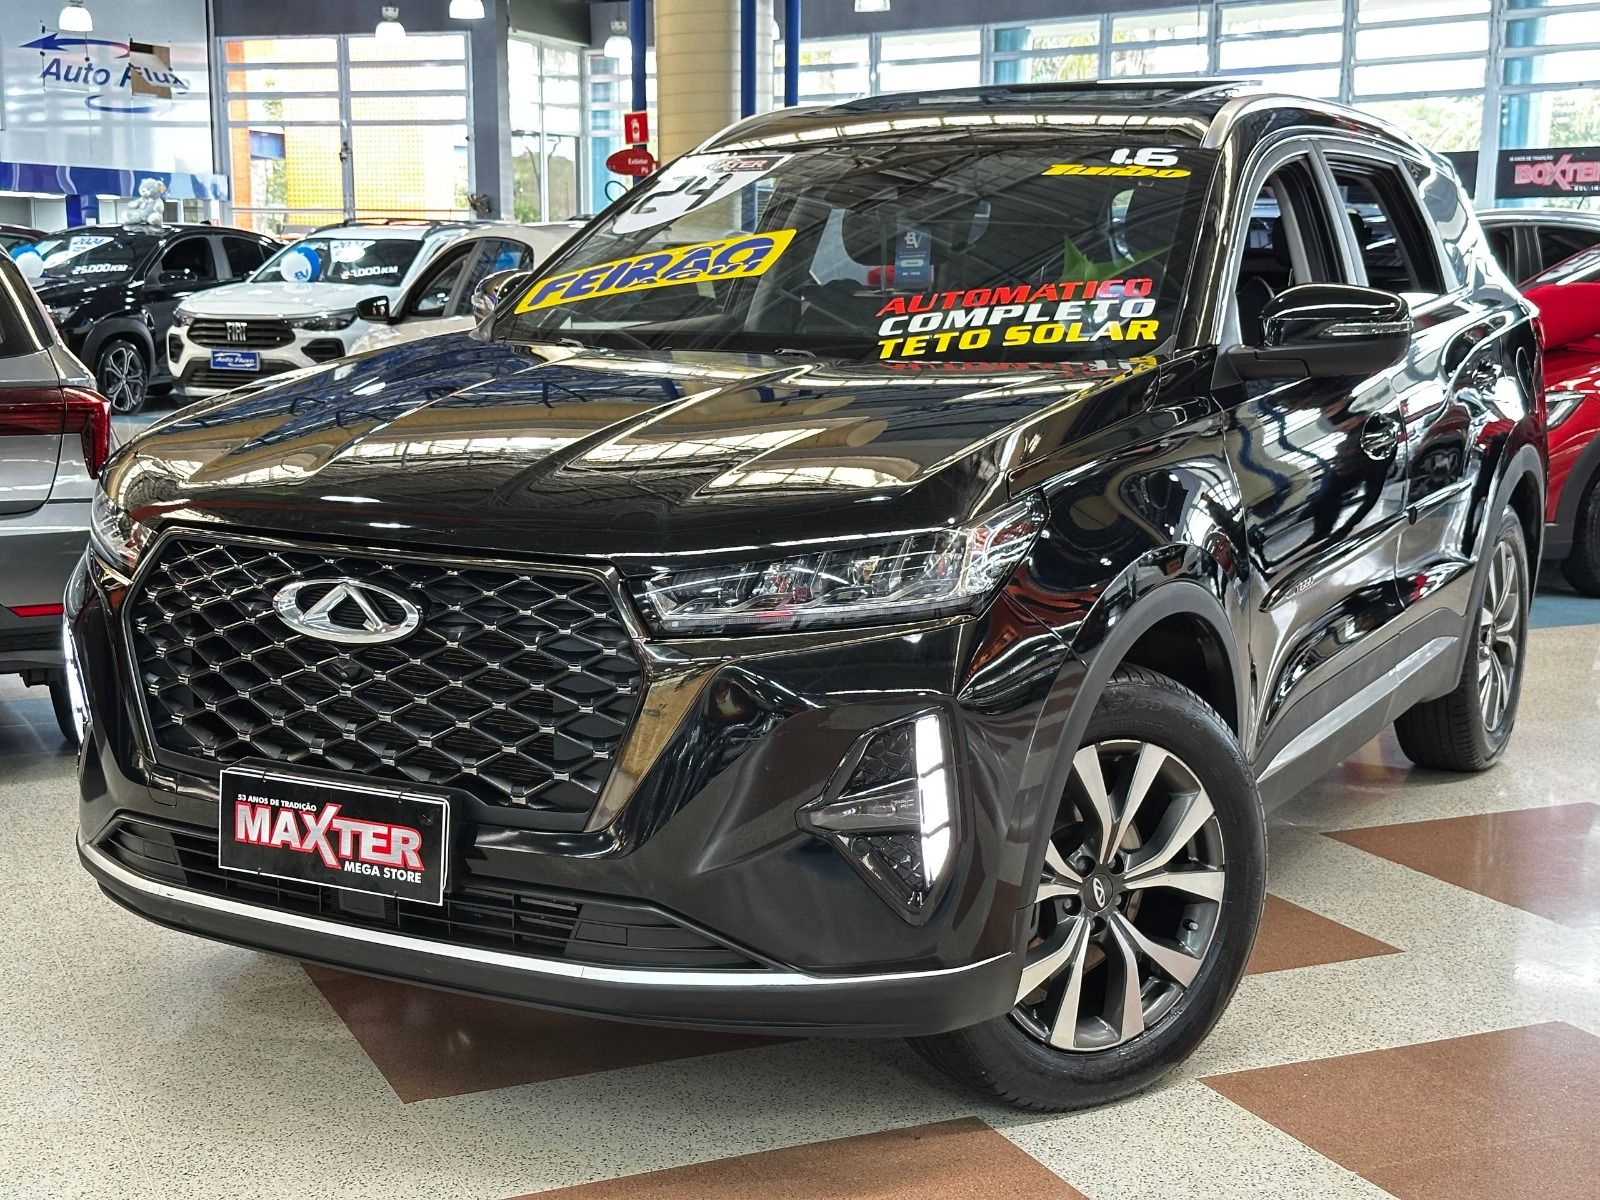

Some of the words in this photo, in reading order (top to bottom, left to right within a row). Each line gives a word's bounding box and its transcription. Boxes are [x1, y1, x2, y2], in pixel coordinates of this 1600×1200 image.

[41, 58, 110, 86] Auto
[1110, 148, 1178, 166] 1.6
[1041, 164, 1191, 178] Turbo
[631, 173, 733, 214] 24
[878, 299, 1156, 337] COMPLETO
[226, 322, 247, 341] FIAT
[877, 329, 991, 359] TETO
[1003, 320, 1159, 346] SOLAR
[237, 793, 247, 802] 53
[248, 795, 269, 806] ANOS
[270, 798, 280, 807] DE
[280, 799, 317, 813] TRADIÇÃO
[235, 803, 425, 871] MAXTER
[344, 860, 380, 877] MEGA
[383, 867, 422, 884] STORE
